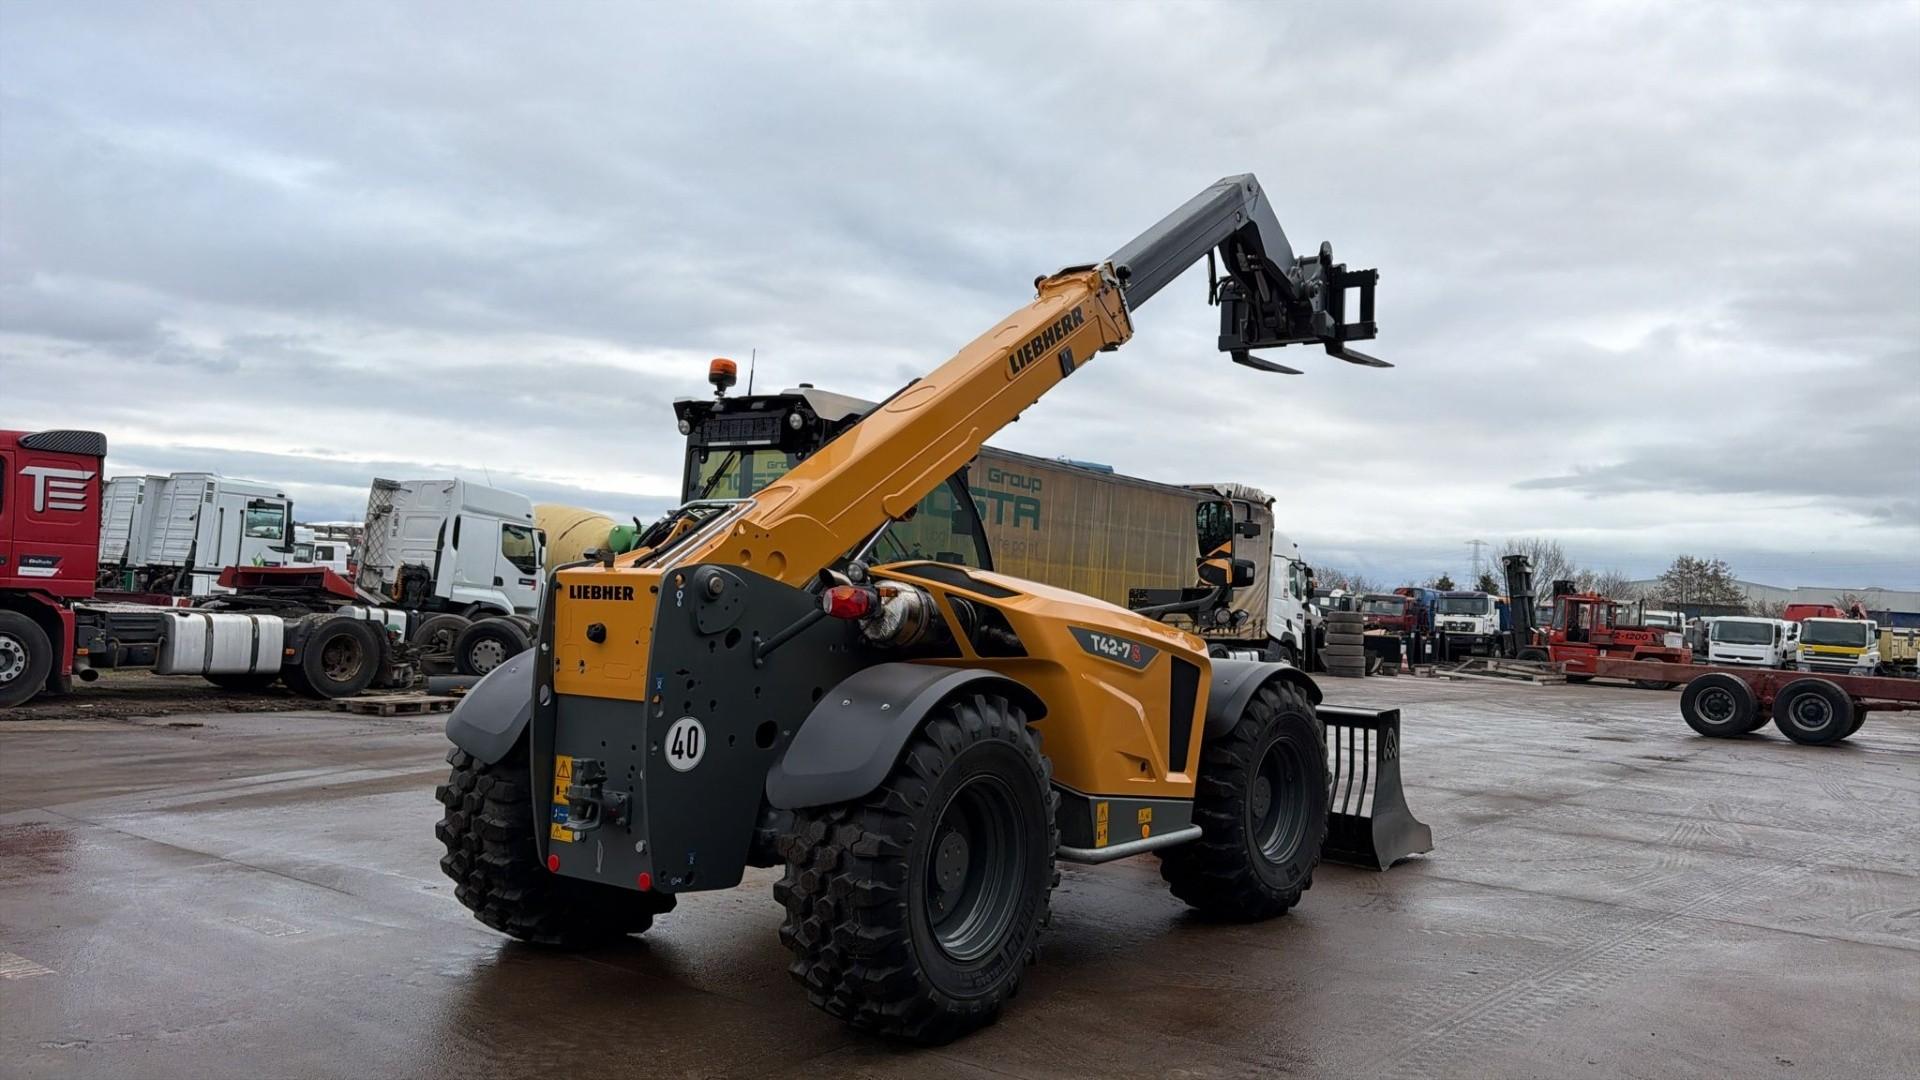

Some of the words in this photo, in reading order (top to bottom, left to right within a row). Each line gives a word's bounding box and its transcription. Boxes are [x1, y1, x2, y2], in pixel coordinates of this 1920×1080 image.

[1009, 306, 1084, 374] LIEBHERR
[988, 467, 1042, 493] Group
[569, 584, 634, 601] LIEBHER
[671, 725, 699, 760] 40
